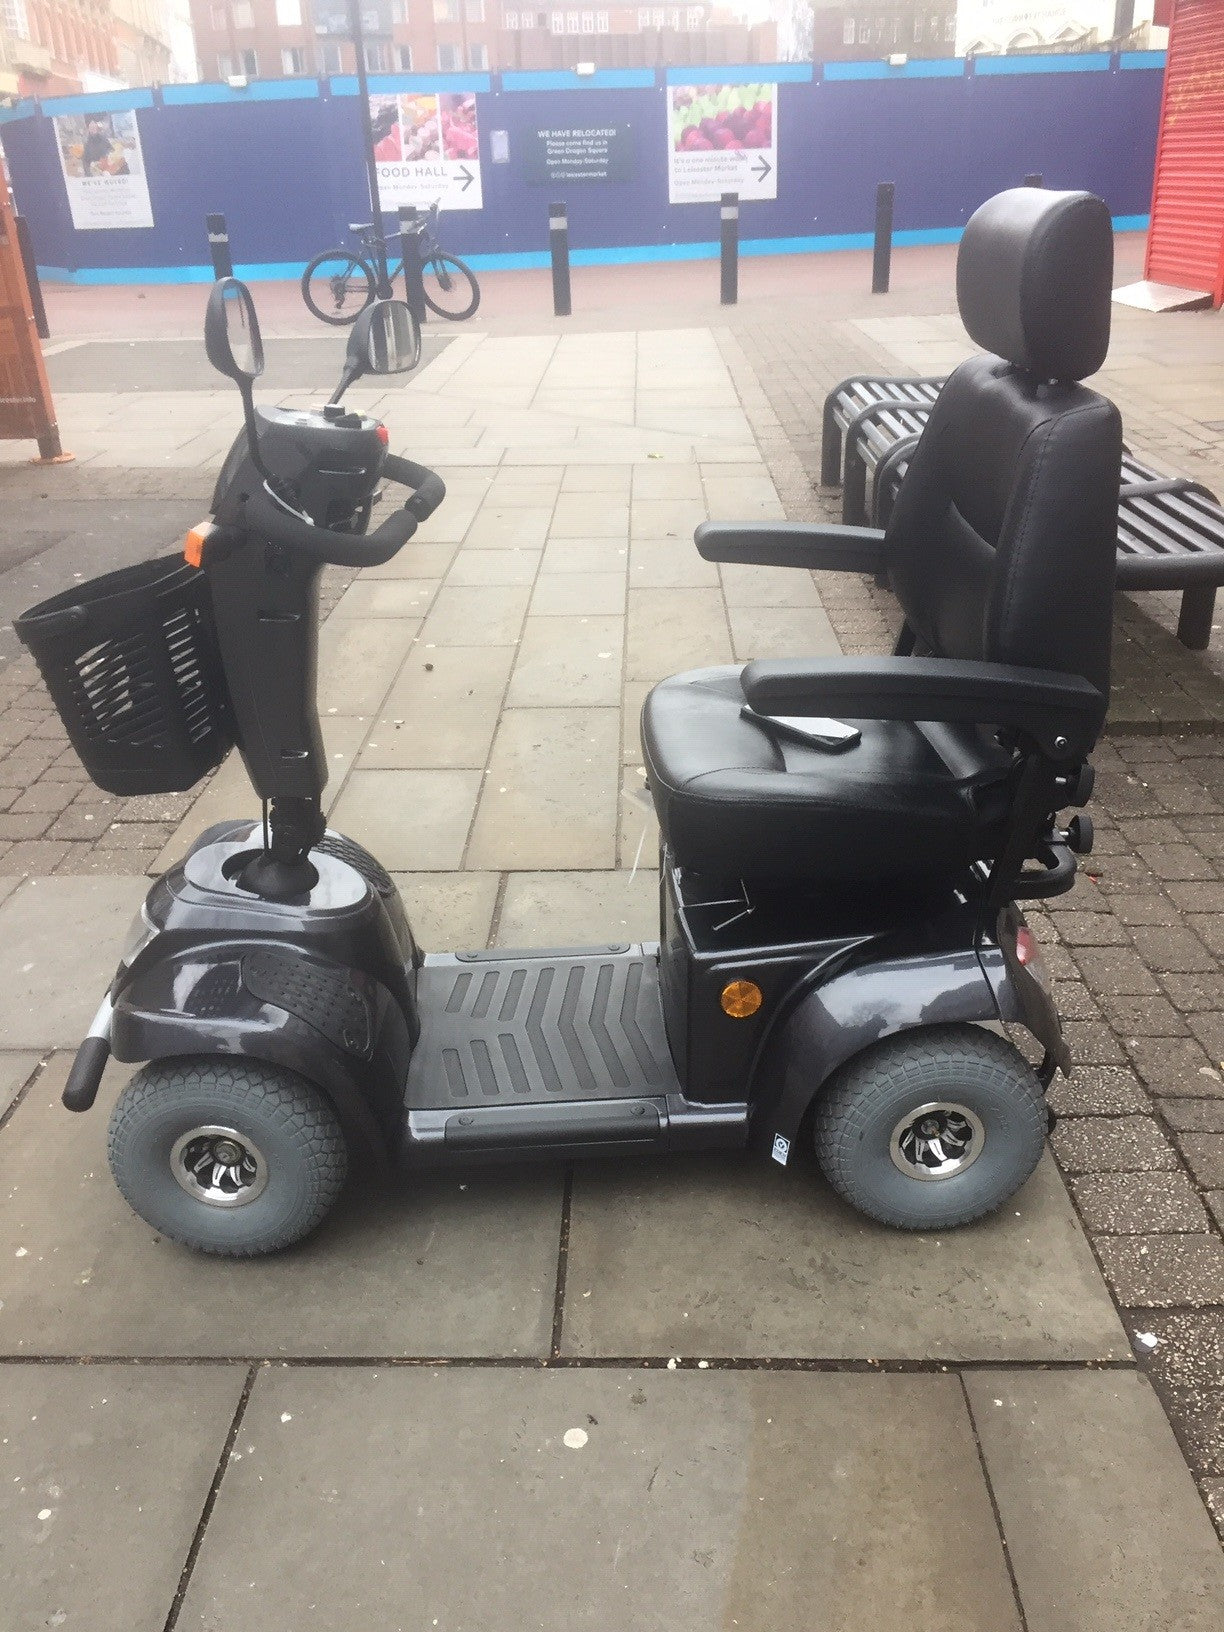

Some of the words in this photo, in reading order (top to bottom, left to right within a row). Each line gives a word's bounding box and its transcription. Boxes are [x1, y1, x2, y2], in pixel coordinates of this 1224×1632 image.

[537, 130, 550, 138] WE
[551, 129, 571, 137] HAVE
[572, 128, 616, 137] RELOCATED!
[565, 147, 587, 155] Dragon
[546, 158, 561, 166] Open
[415, 166, 448, 177] HALL
